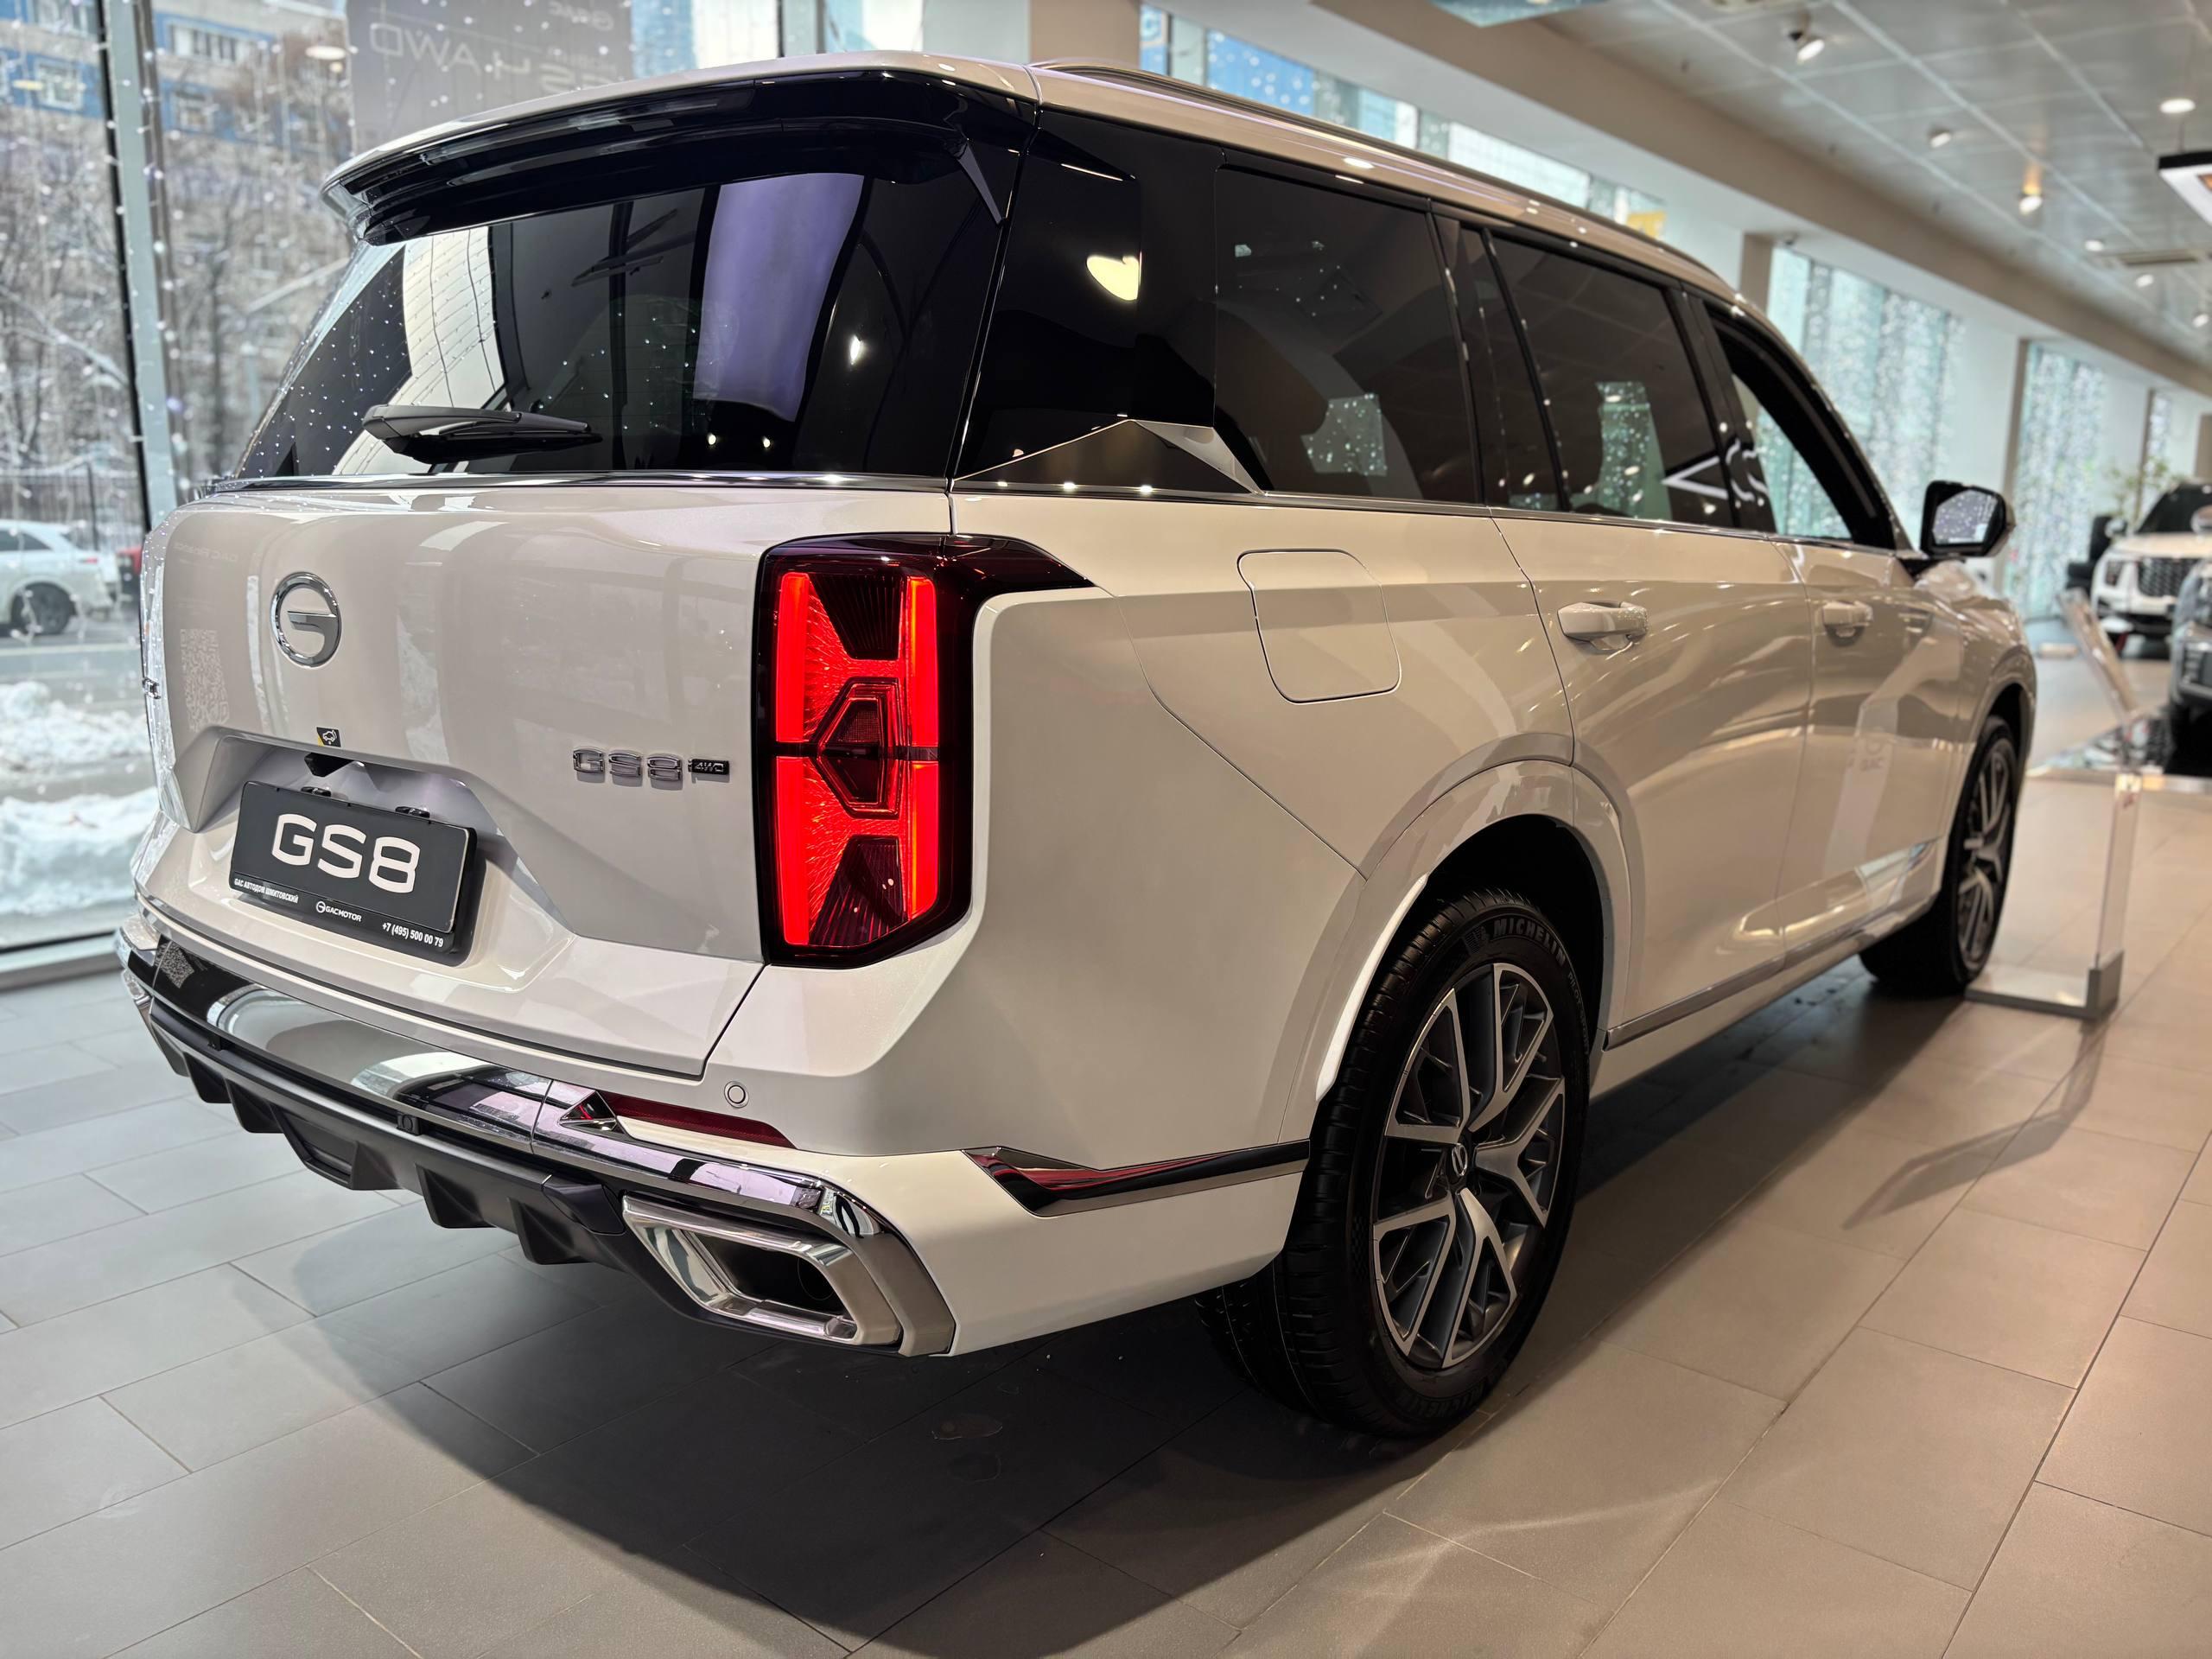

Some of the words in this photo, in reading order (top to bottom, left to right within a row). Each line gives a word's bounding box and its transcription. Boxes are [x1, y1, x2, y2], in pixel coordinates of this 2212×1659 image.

[573, 747, 683, 782] GS8
[271, 813, 421, 893] GS8
[244, 880, 264, 893] АВТОДОМ
[265, 887, 299, 904] ШМИТОВСКИЙ
[382, 922, 391, 932] +7
[391, 925, 410, 940] (495)
[410, 930, 423, 942] 500
[423, 934, 433, 944] 00
[434, 937, 444, 948] 79
[1493, 918, 1566, 967] MICHELIN
